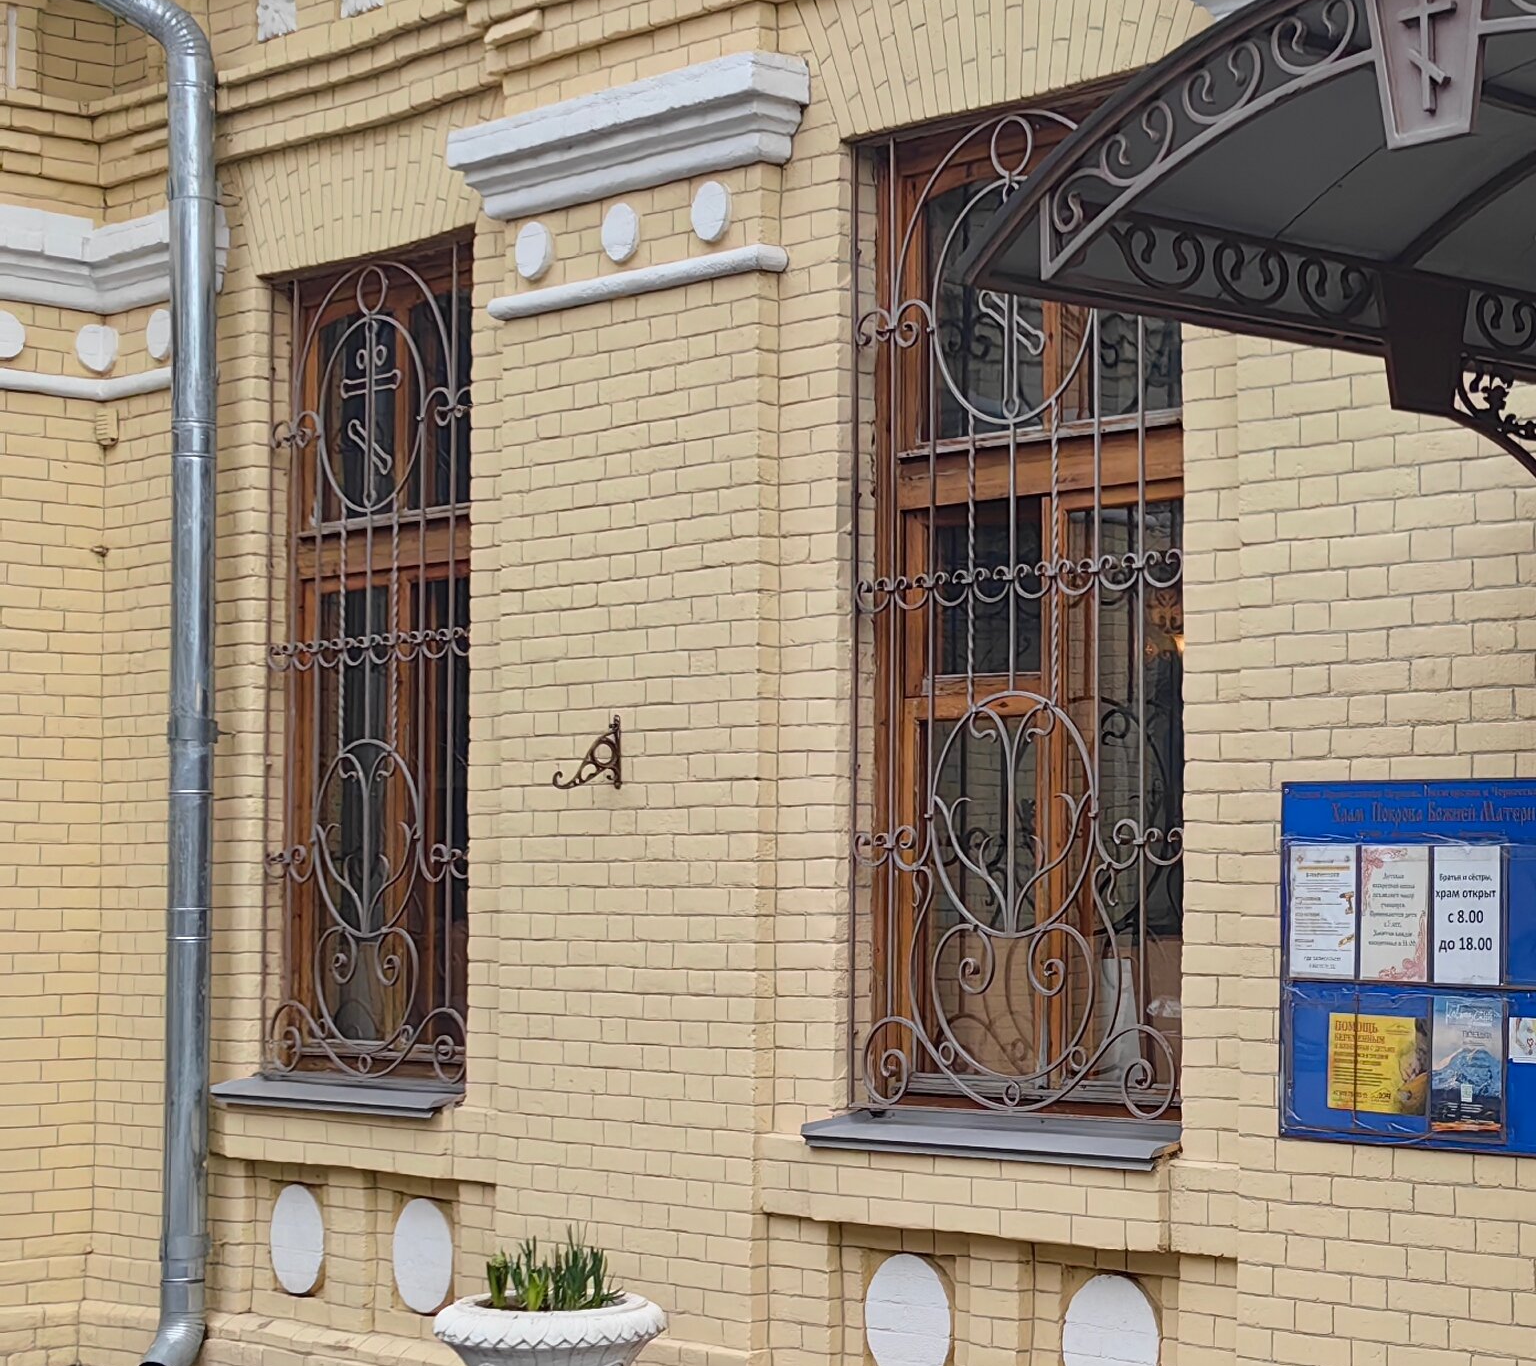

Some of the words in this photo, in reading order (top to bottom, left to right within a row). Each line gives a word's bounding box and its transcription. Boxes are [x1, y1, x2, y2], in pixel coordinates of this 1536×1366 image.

[1480, 801, 1536, 826] Матери
[1435, 889, 1460, 900] храм
[1462, 889, 1497, 901] открыт
[1447, 912, 1455, 924] с
[1457, 909, 1484, 924] 8.00
[1438, 939, 1456, 953] до
[1458, 936, 1493, 951] 18.00
